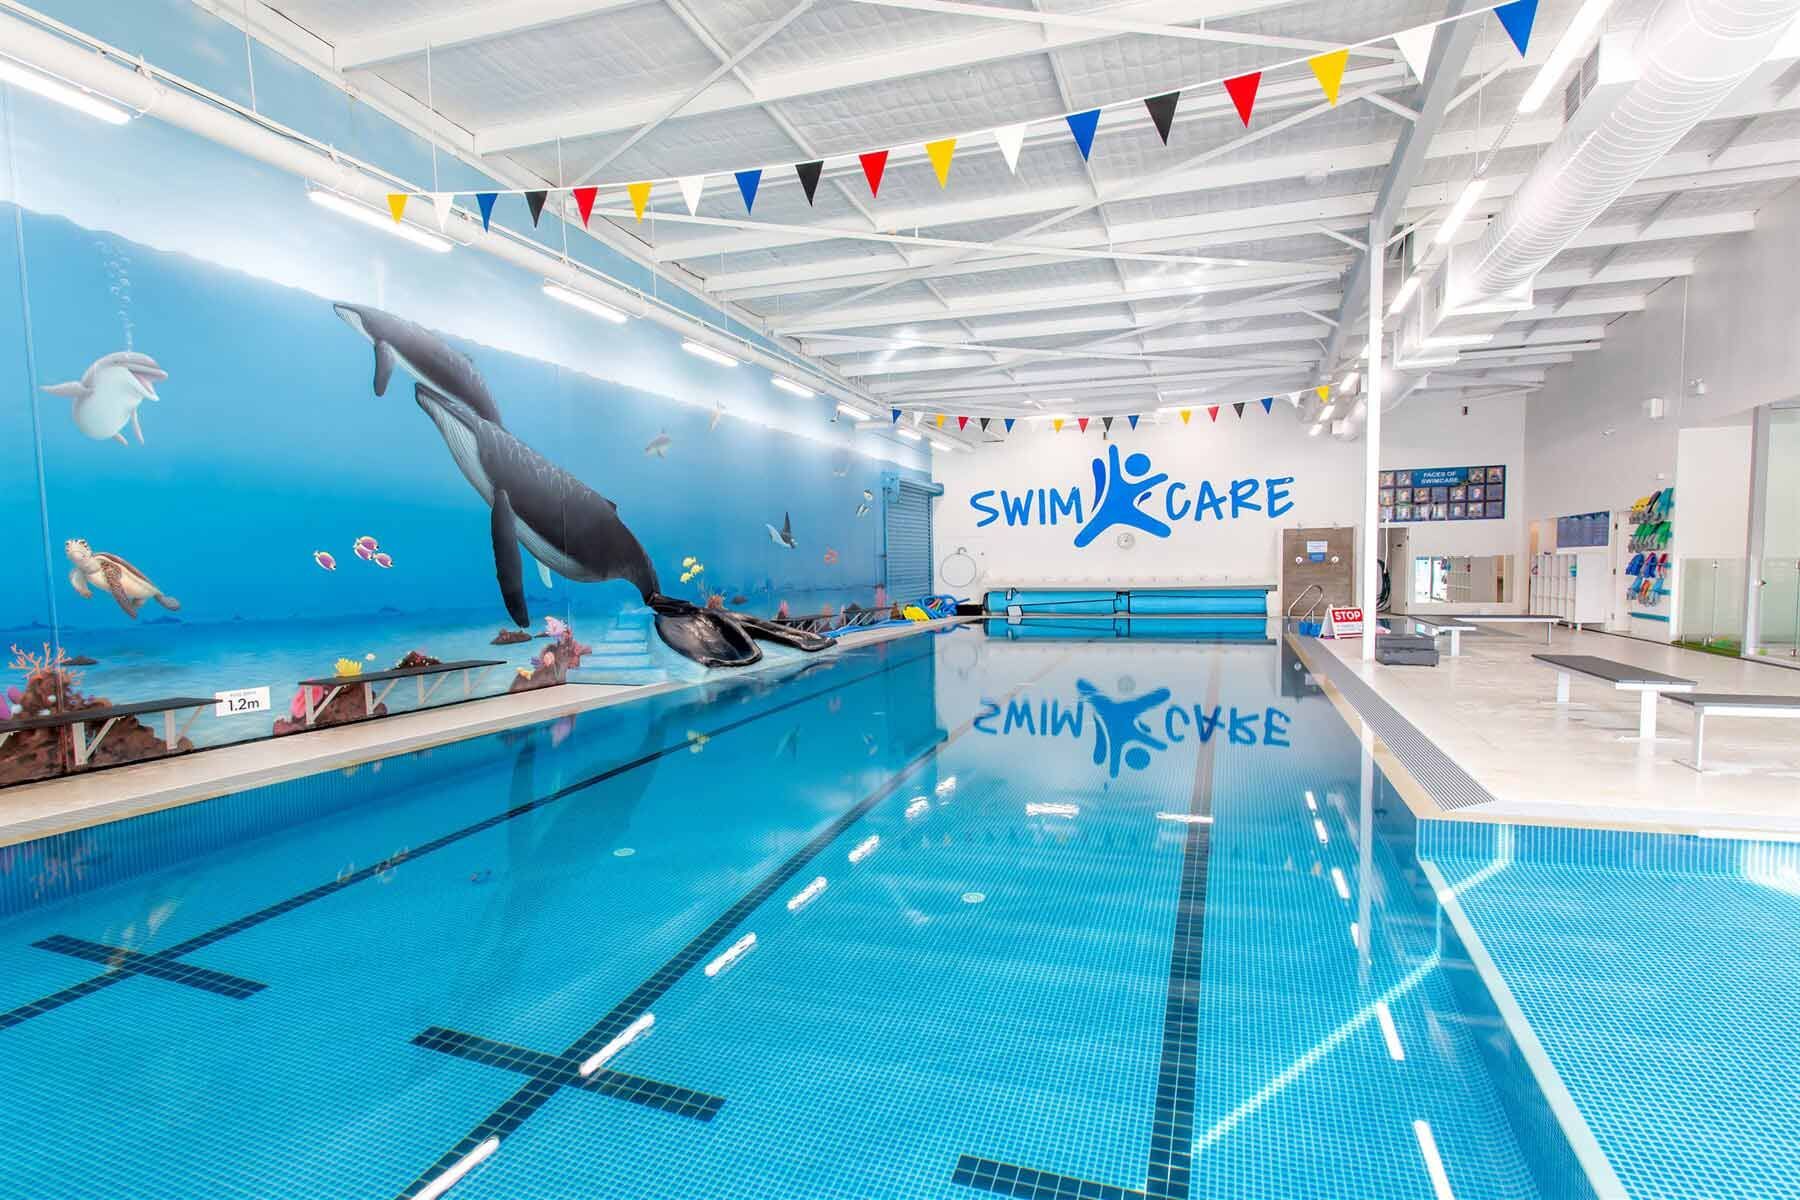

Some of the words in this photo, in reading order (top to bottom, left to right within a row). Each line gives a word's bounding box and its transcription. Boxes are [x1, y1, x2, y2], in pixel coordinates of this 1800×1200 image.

[969, 486, 1084, 527] SWIM
[1165, 476, 1295, 521] CARE
[1335, 611, 1361, 620] STOP
[228, 698, 260, 711] 1.2m
